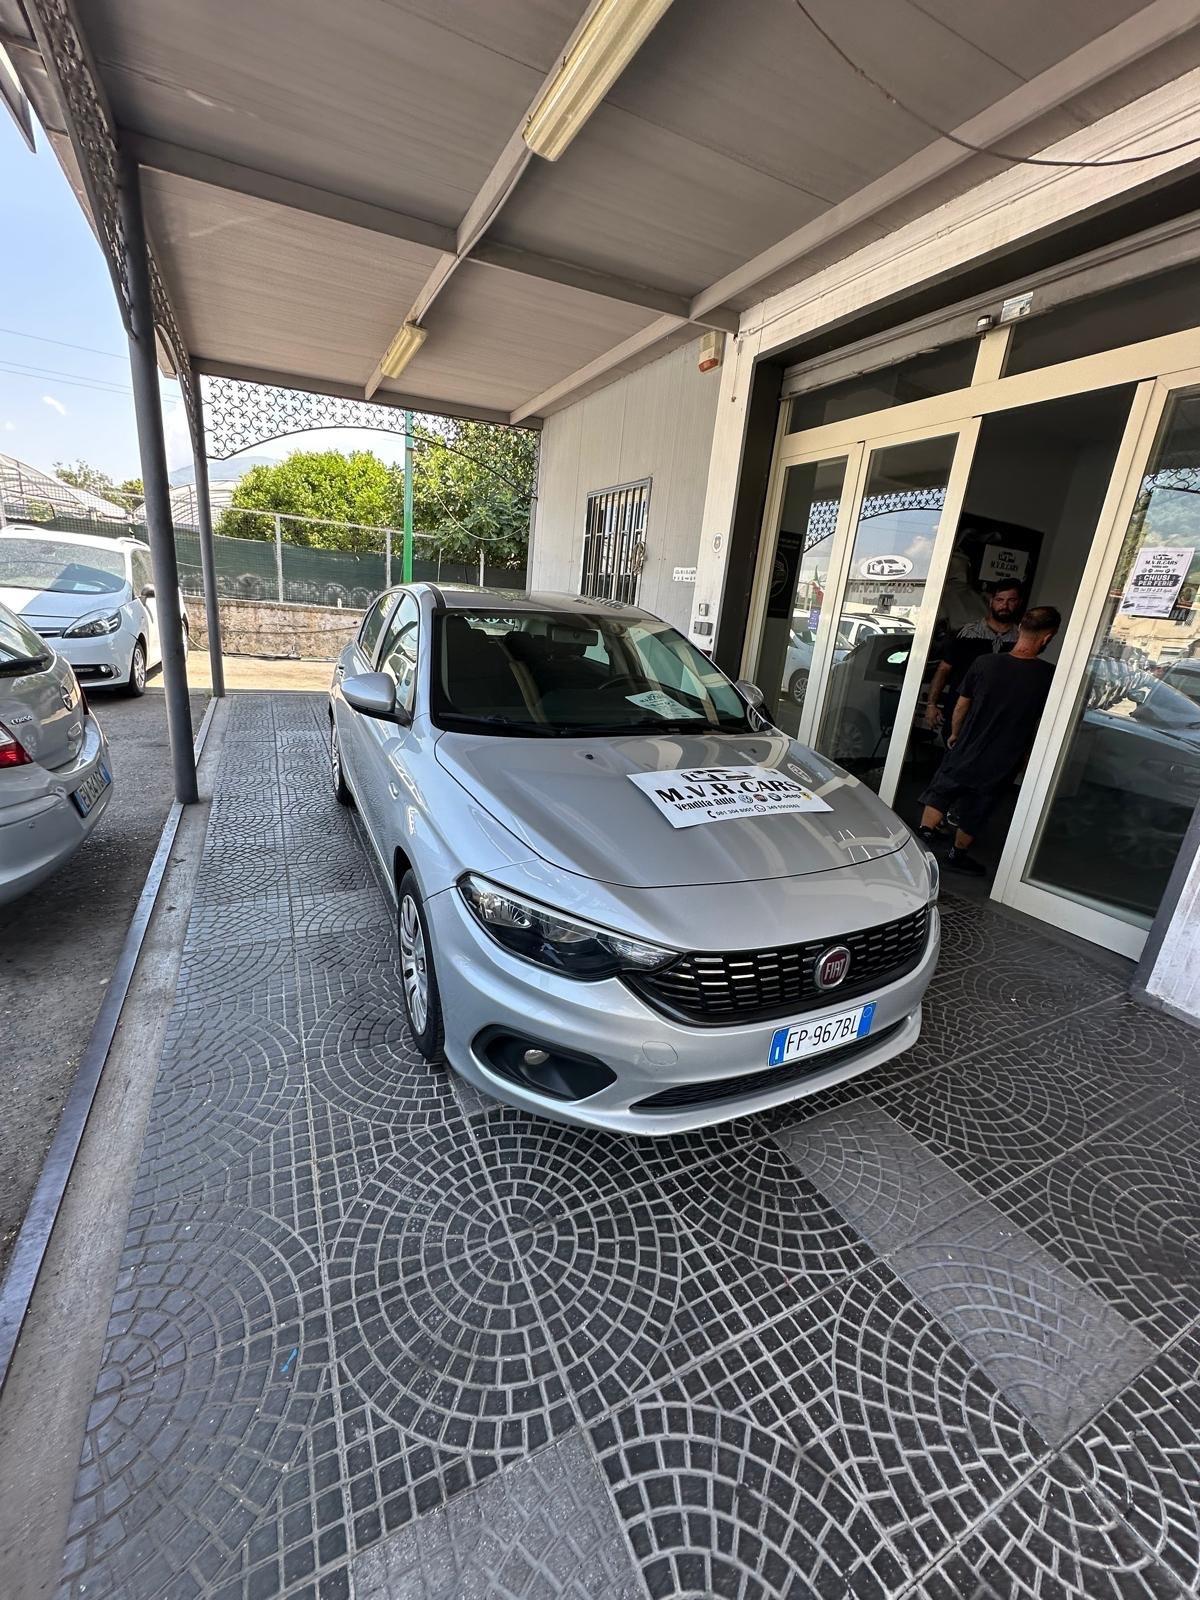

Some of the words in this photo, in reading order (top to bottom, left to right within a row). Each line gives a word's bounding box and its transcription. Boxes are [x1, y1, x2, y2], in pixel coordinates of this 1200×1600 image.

[654, 781, 802, 803] M.V.R.CARS
[674, 800, 714, 811] Vendita
[714, 796, 737, 806] auto
[824, 958, 845, 980] FIAT
